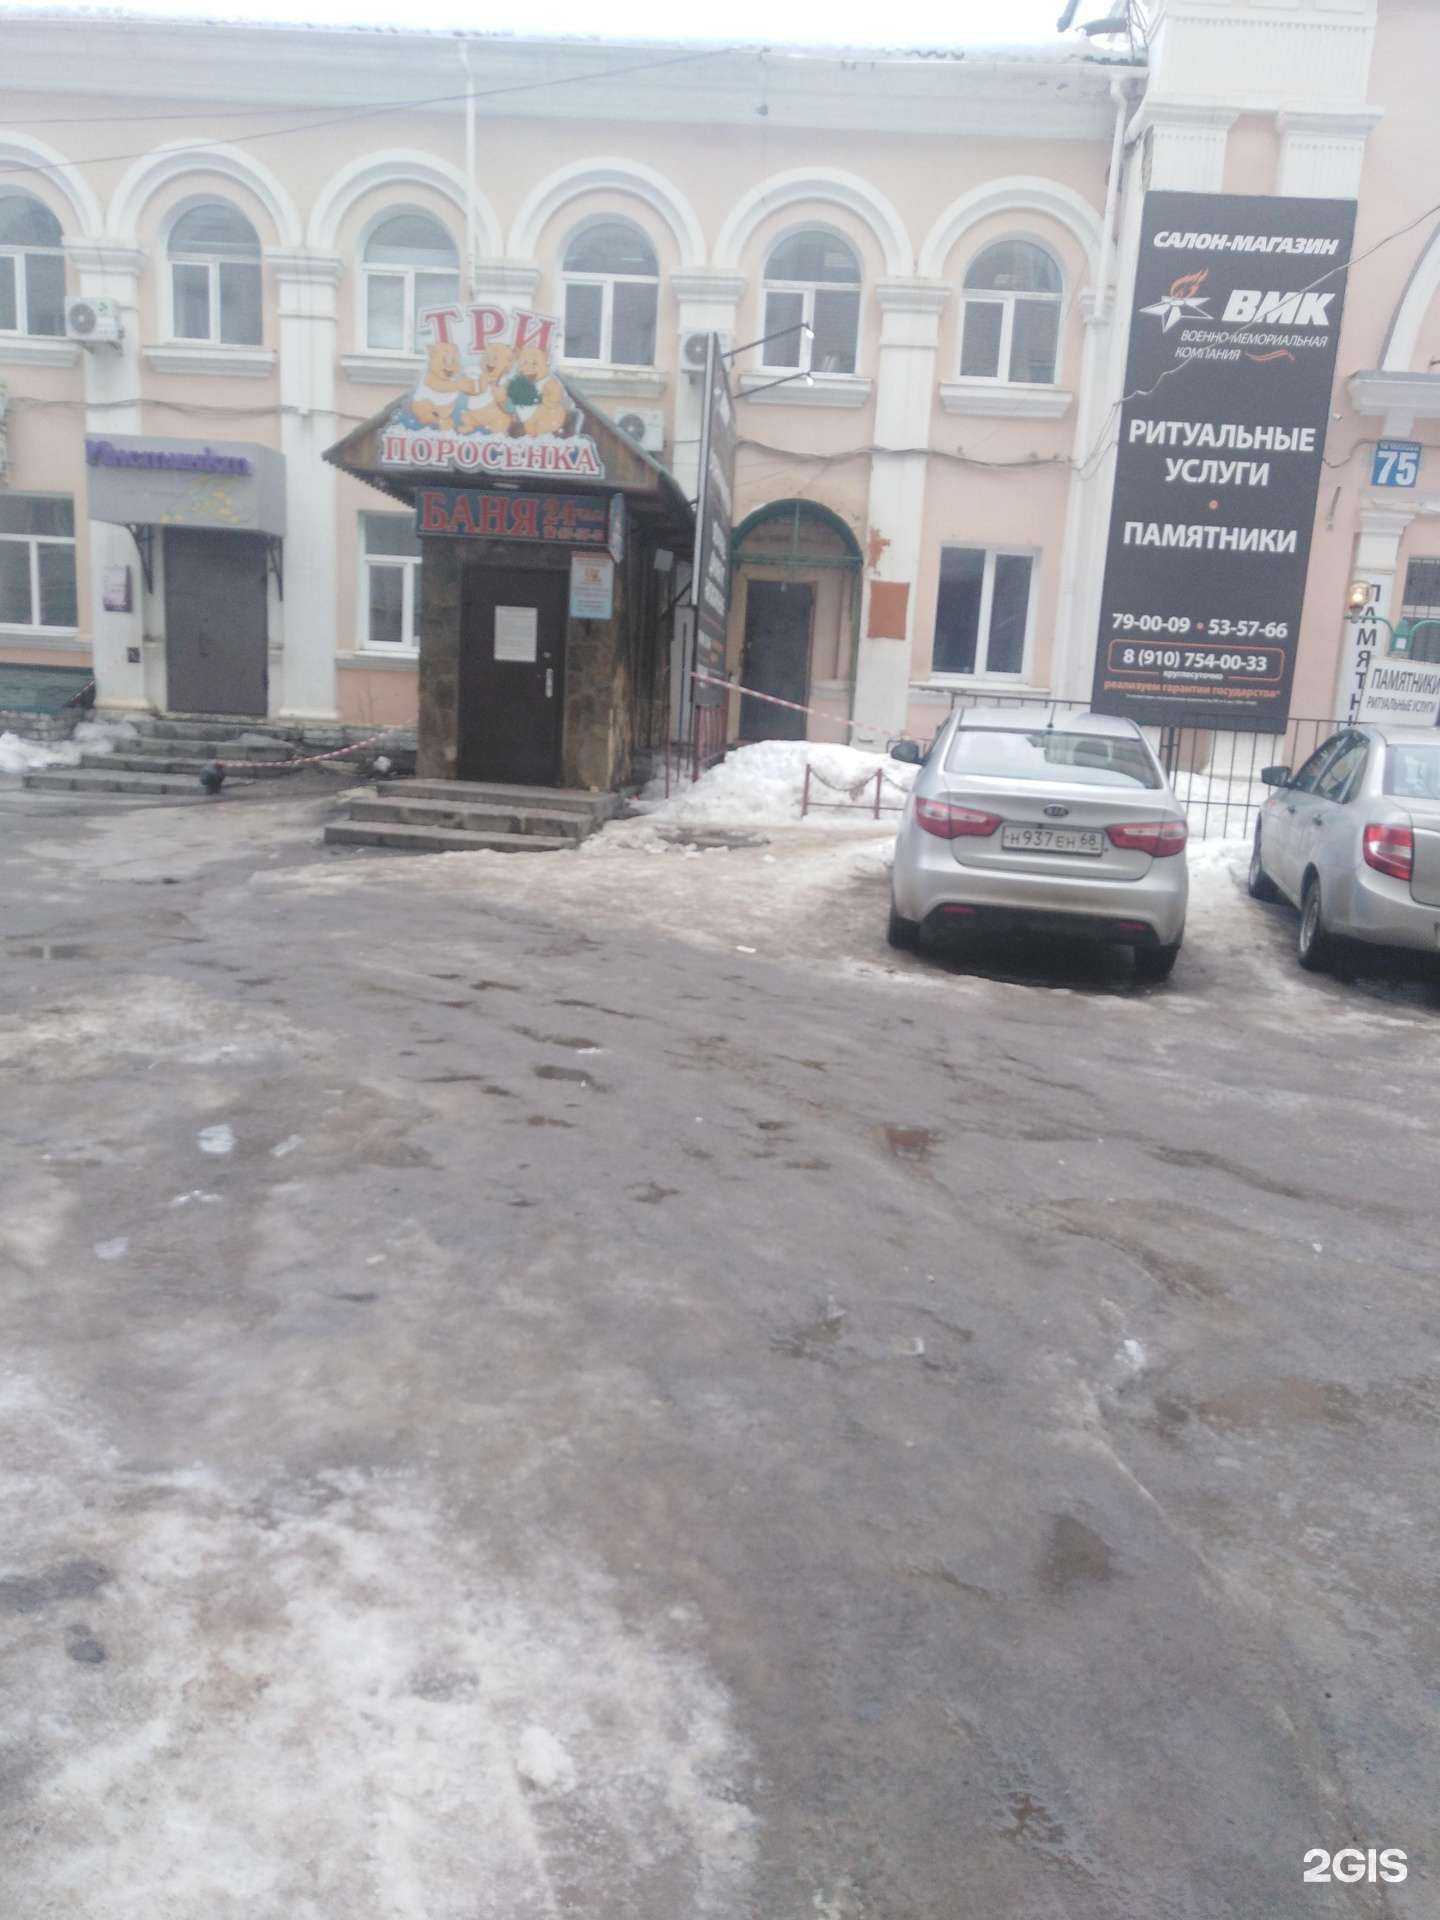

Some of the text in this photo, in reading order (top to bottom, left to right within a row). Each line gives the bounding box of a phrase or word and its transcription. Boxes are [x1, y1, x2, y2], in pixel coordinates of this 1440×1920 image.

[1153, 230, 1340, 256] САЛОН-МАГАЗИН
[1221, 288, 1336, 326] ВМК
[421, 306, 557, 355] ТРИ
[1180, 329, 1329, 348] ВОЕННО-МЕМОРИАЛЬНАЯ
[1174, 346, 1242, 361] КОМПАНИЯ
[1128, 418, 1317, 452] РИТУАЛЬНЫЕ
[383, 436, 600, 474] ПОРОСЕНКА
[1376, 450, 1419, 486] 75
[1164, 457, 1271, 487] УСЛУГИ
[422, 491, 539, 537] БАНЯ
[1122, 521, 1298, 554] ПАМЯТНИКИ
[1112, 613, 1289, 638] 79-00-09 53-57-66
[1122, 648, 1268, 672] 8 (910) 754-00-33
